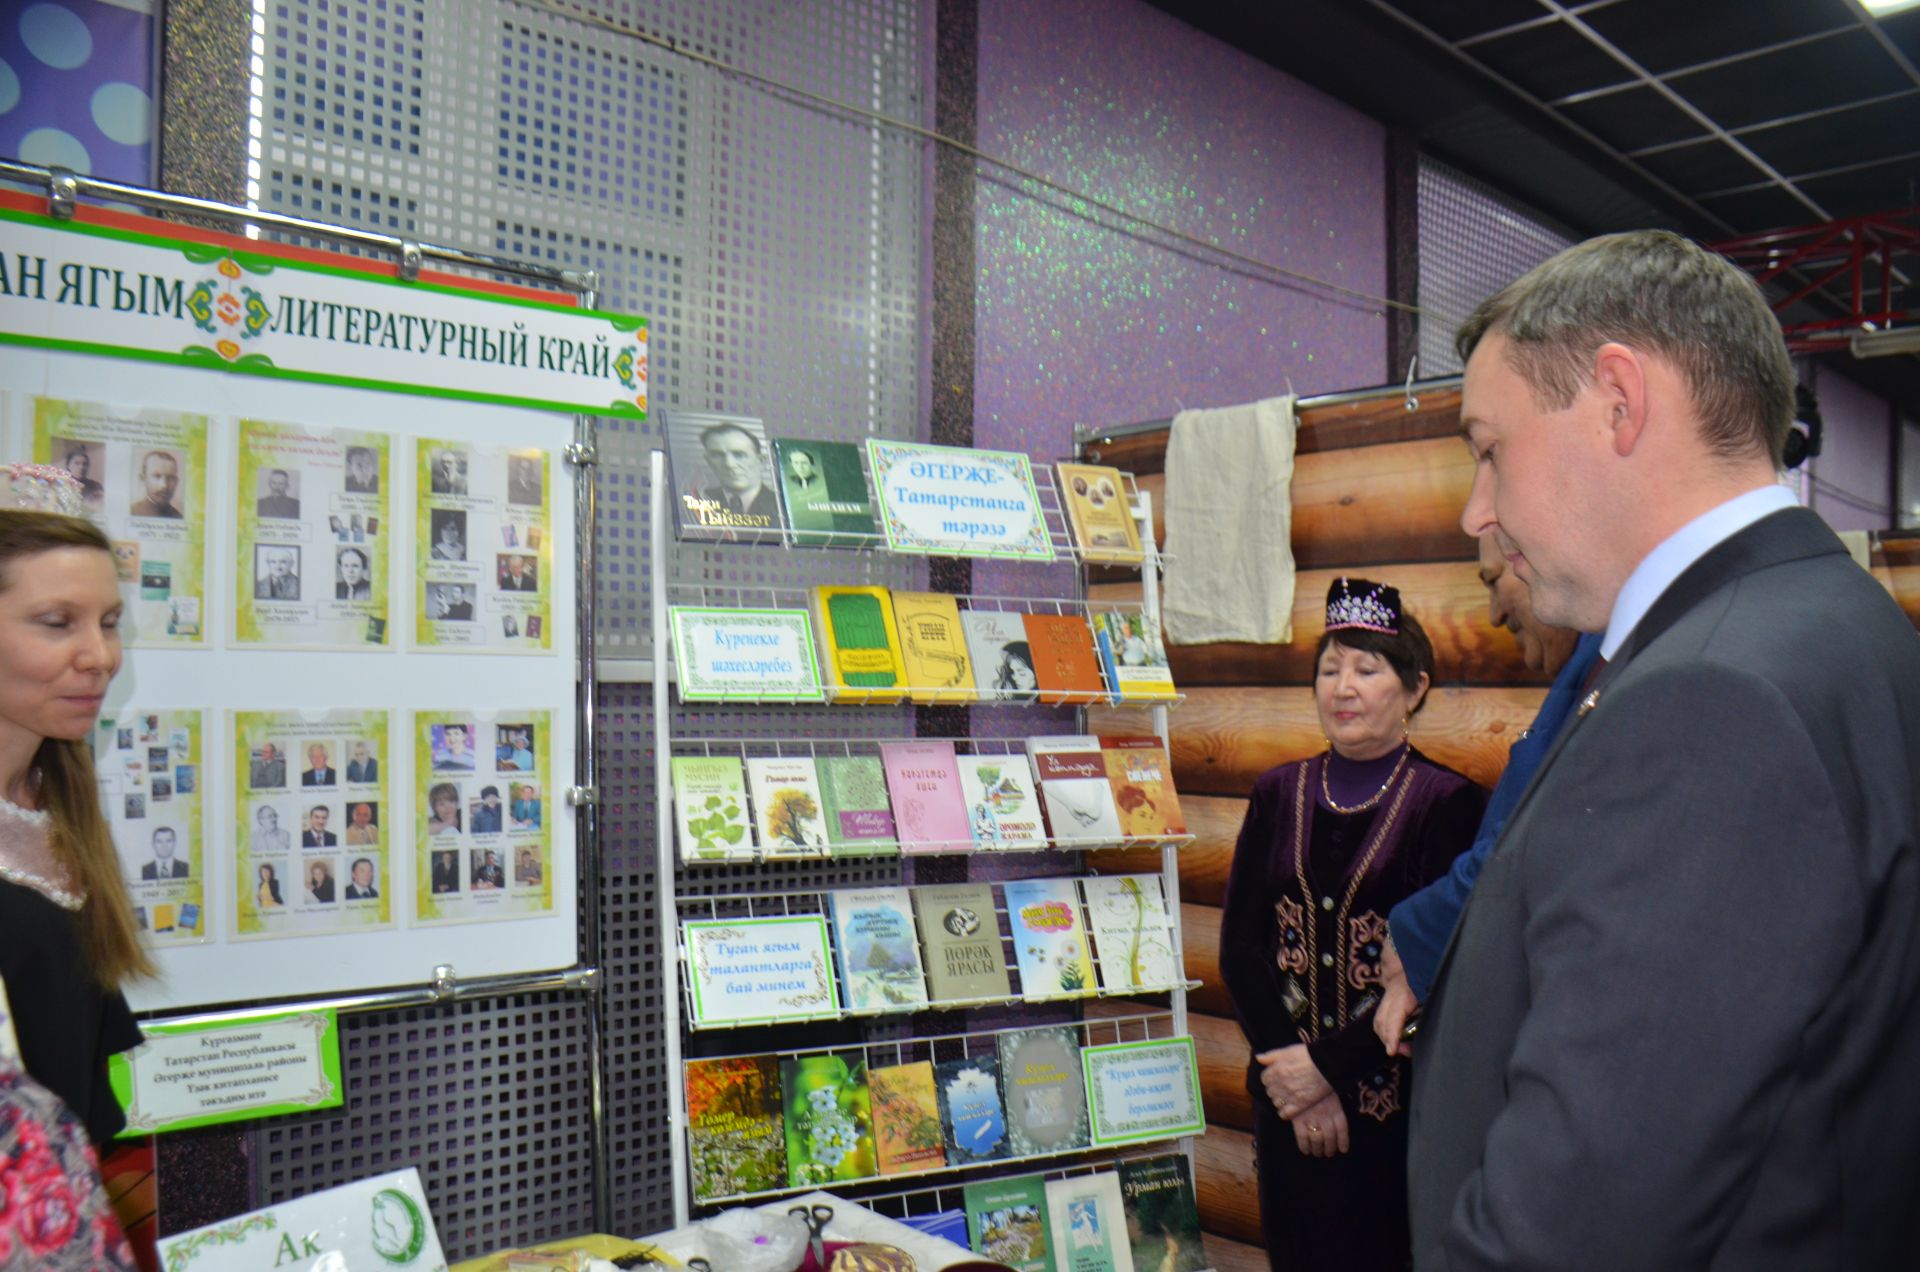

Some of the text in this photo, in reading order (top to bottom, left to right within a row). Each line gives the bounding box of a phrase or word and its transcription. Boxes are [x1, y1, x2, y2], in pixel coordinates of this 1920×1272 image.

[56, 262, 185, 319] ЯГЫМ
[270, 296, 610, 379] ЛИТЕРАТУРНЫЙ КРАЙ
[893, 487, 1027, 513] Татарстанга
[716, 942, 801, 957] Туган ягым
[944, 945, 993, 962] ЙӨРӘК
[709, 960, 813, 977] талантларга
[947, 960, 995, 977] ЯРАСЫ
[725, 980, 806, 994] бай минем
[164, 1042, 297, 1067] Татарстан Республикасы
[197, 1061, 266, 1079] муниципаль
[266, 1055, 307, 1071] районы
[273, 1228, 322, 1268] Ак
